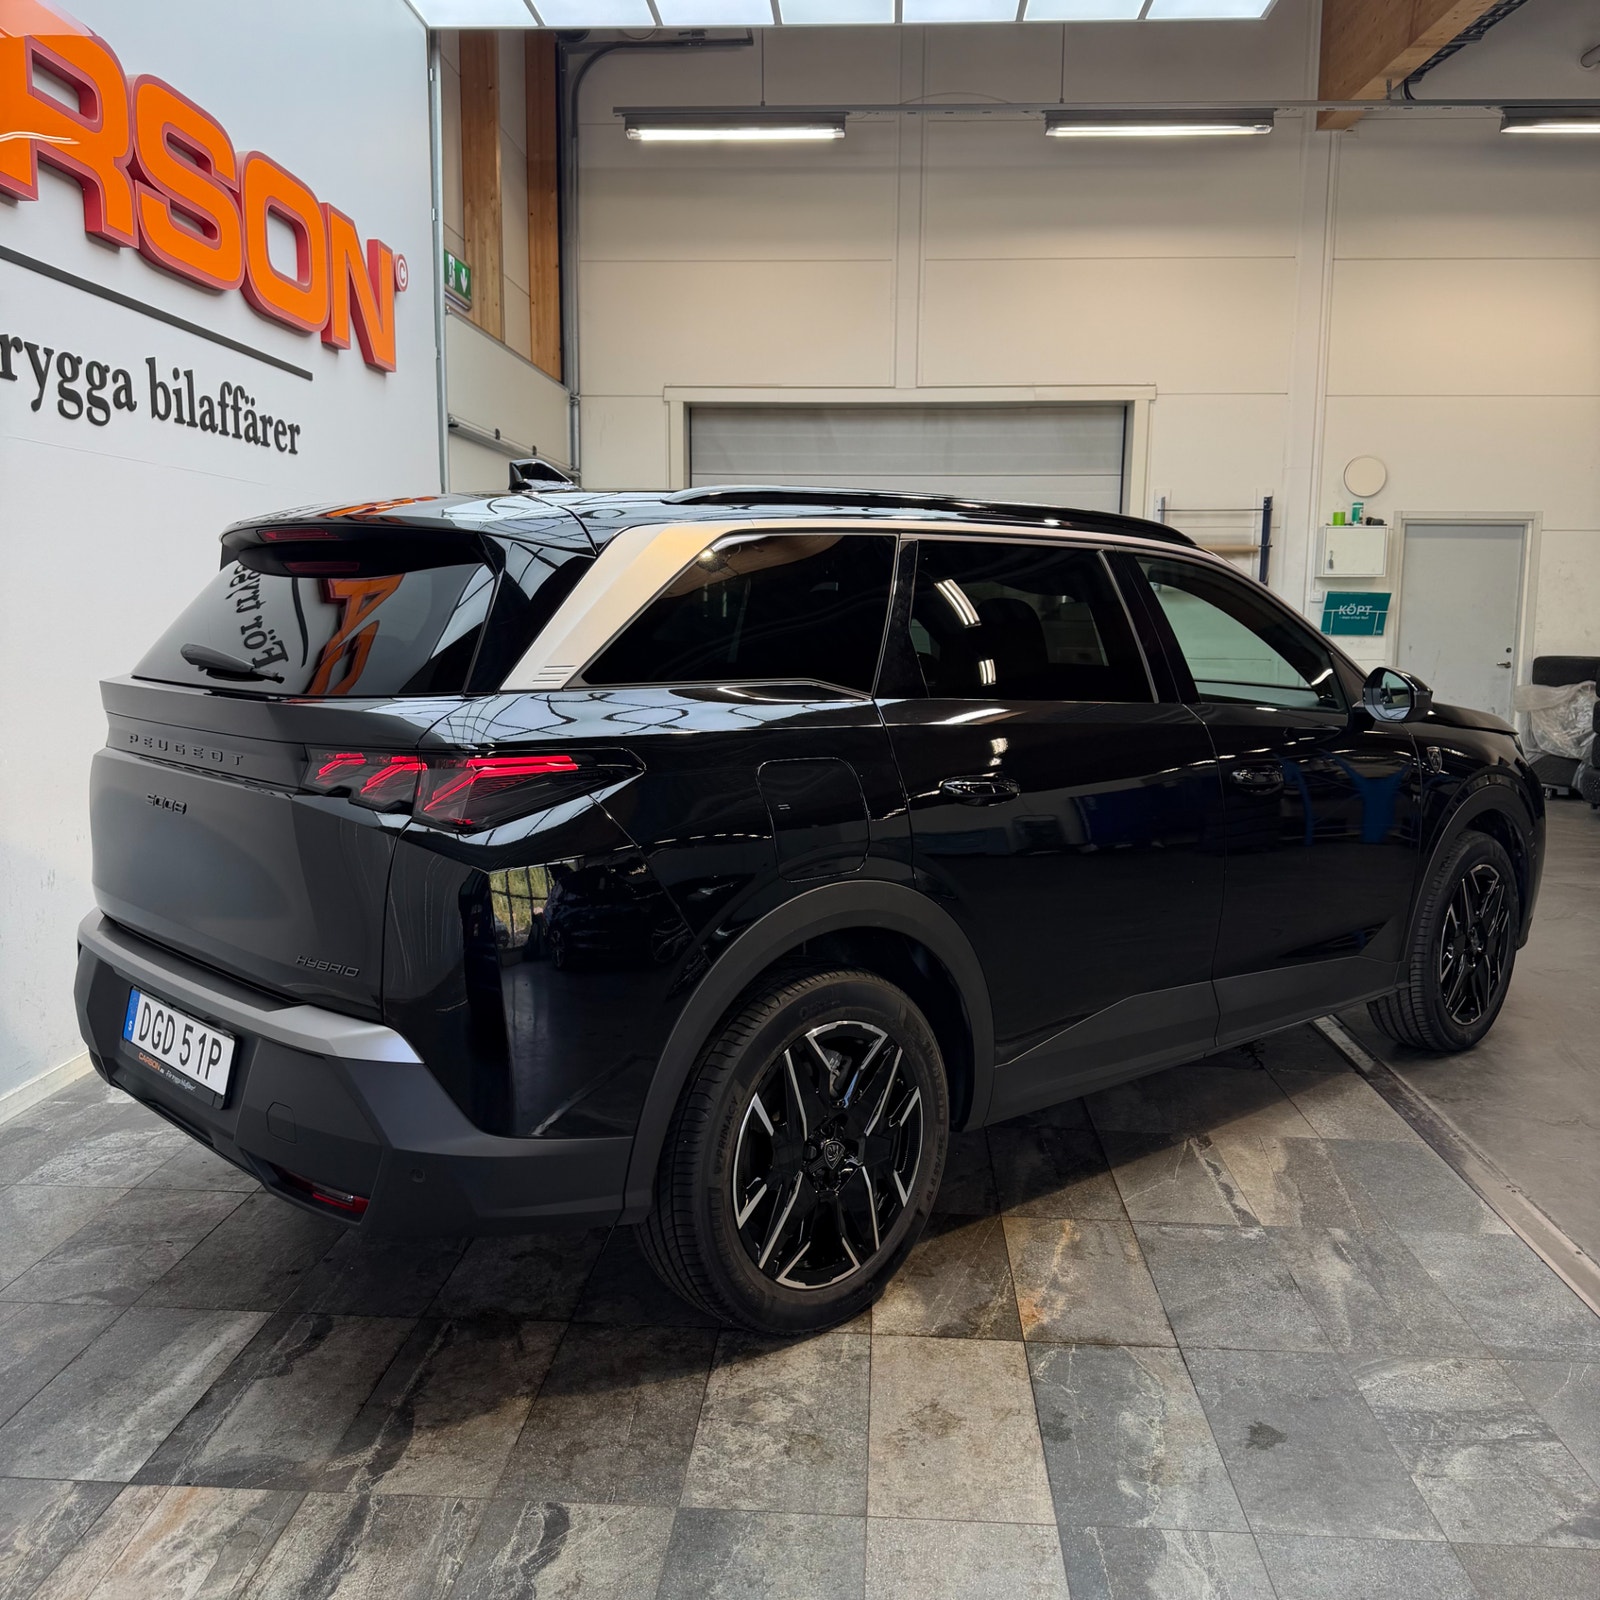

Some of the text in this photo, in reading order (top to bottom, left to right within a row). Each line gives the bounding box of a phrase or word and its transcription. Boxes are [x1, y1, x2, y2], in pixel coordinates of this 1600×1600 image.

[0, 334, 301, 455] rygga bilaffärer
[1338, 602, 1373, 616] KÖPT
[129, 733, 245, 766] PEUGEOT
[145, 793, 187, 815] 5008
[295, 955, 360, 977] HYBRID
[127, 1001, 222, 1080] S DGD 51P
